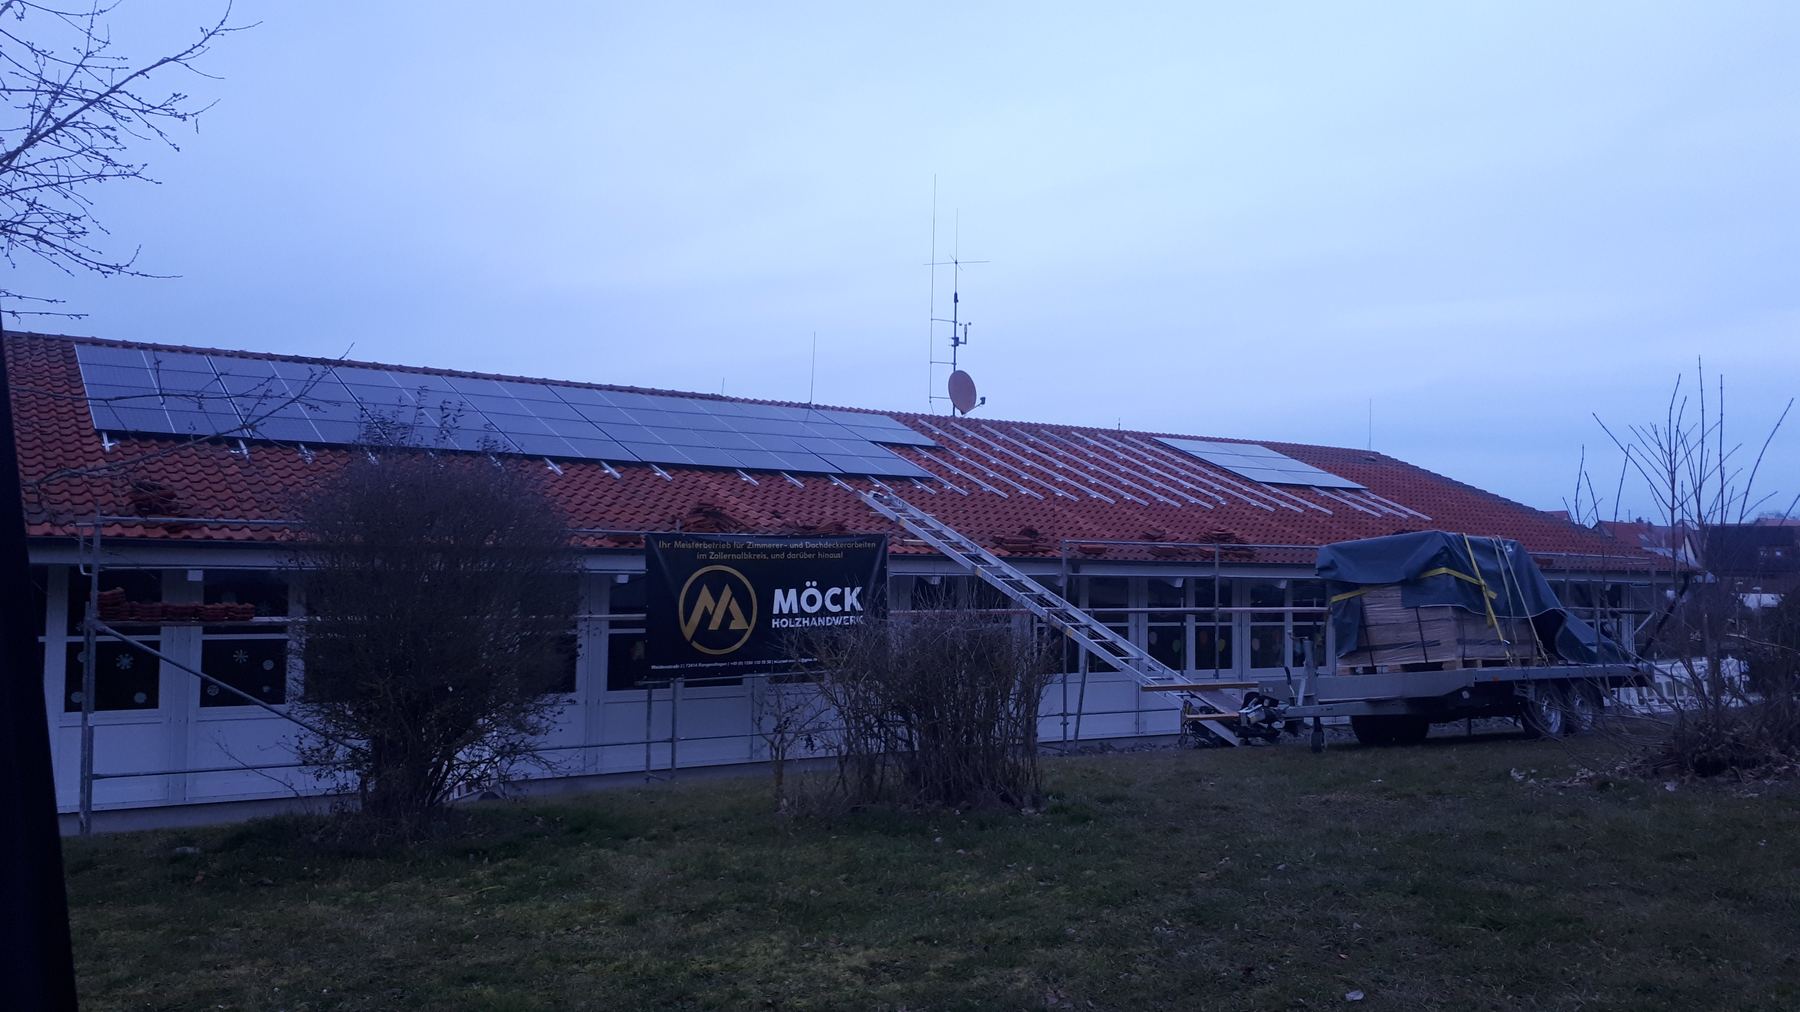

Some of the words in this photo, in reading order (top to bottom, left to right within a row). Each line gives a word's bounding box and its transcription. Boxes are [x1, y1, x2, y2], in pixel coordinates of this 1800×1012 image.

[658, 540, 671, 549] Ihr
[674, 540, 732, 549] Meisterbetrieb
[733, 540, 744, 549] für
[790, 541, 803, 549] und
[805, 541, 876, 549] Dachdeckerarbeiten
[696, 551, 707, 560] im
[770, 551, 785, 560] und
[786, 551, 815, 560] darüber
[817, 551, 844, 559] hinaus!
[772, 580, 864, 614] MÖCK
[771, 615, 865, 629] HOLZHANDWERK
